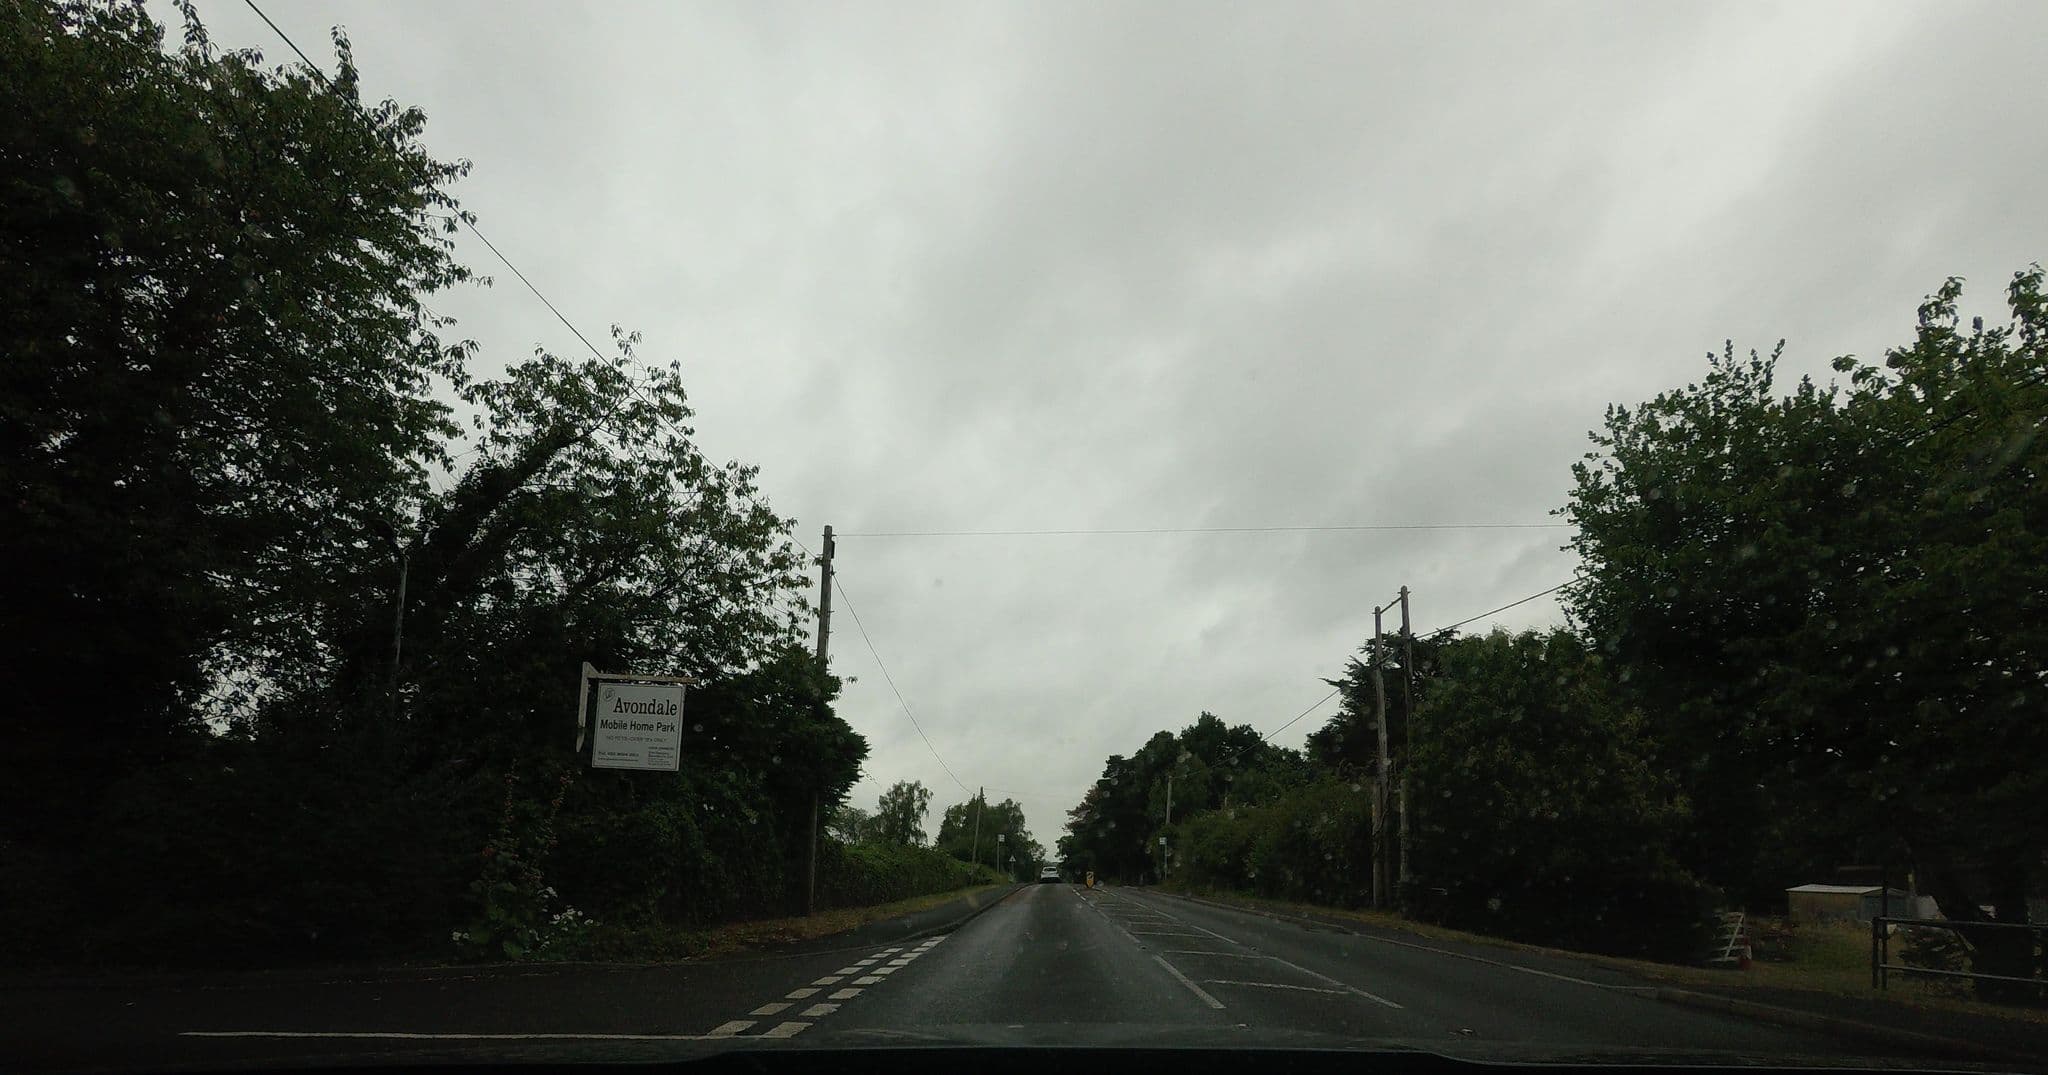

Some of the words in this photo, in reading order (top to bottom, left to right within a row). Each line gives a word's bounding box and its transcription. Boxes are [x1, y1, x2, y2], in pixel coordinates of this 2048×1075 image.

[613, 697, 677, 716] Avondale
[600, 719, 627, 730] Mobile
[630, 720, 655, 731] Home
[656, 722, 675, 732] Park
